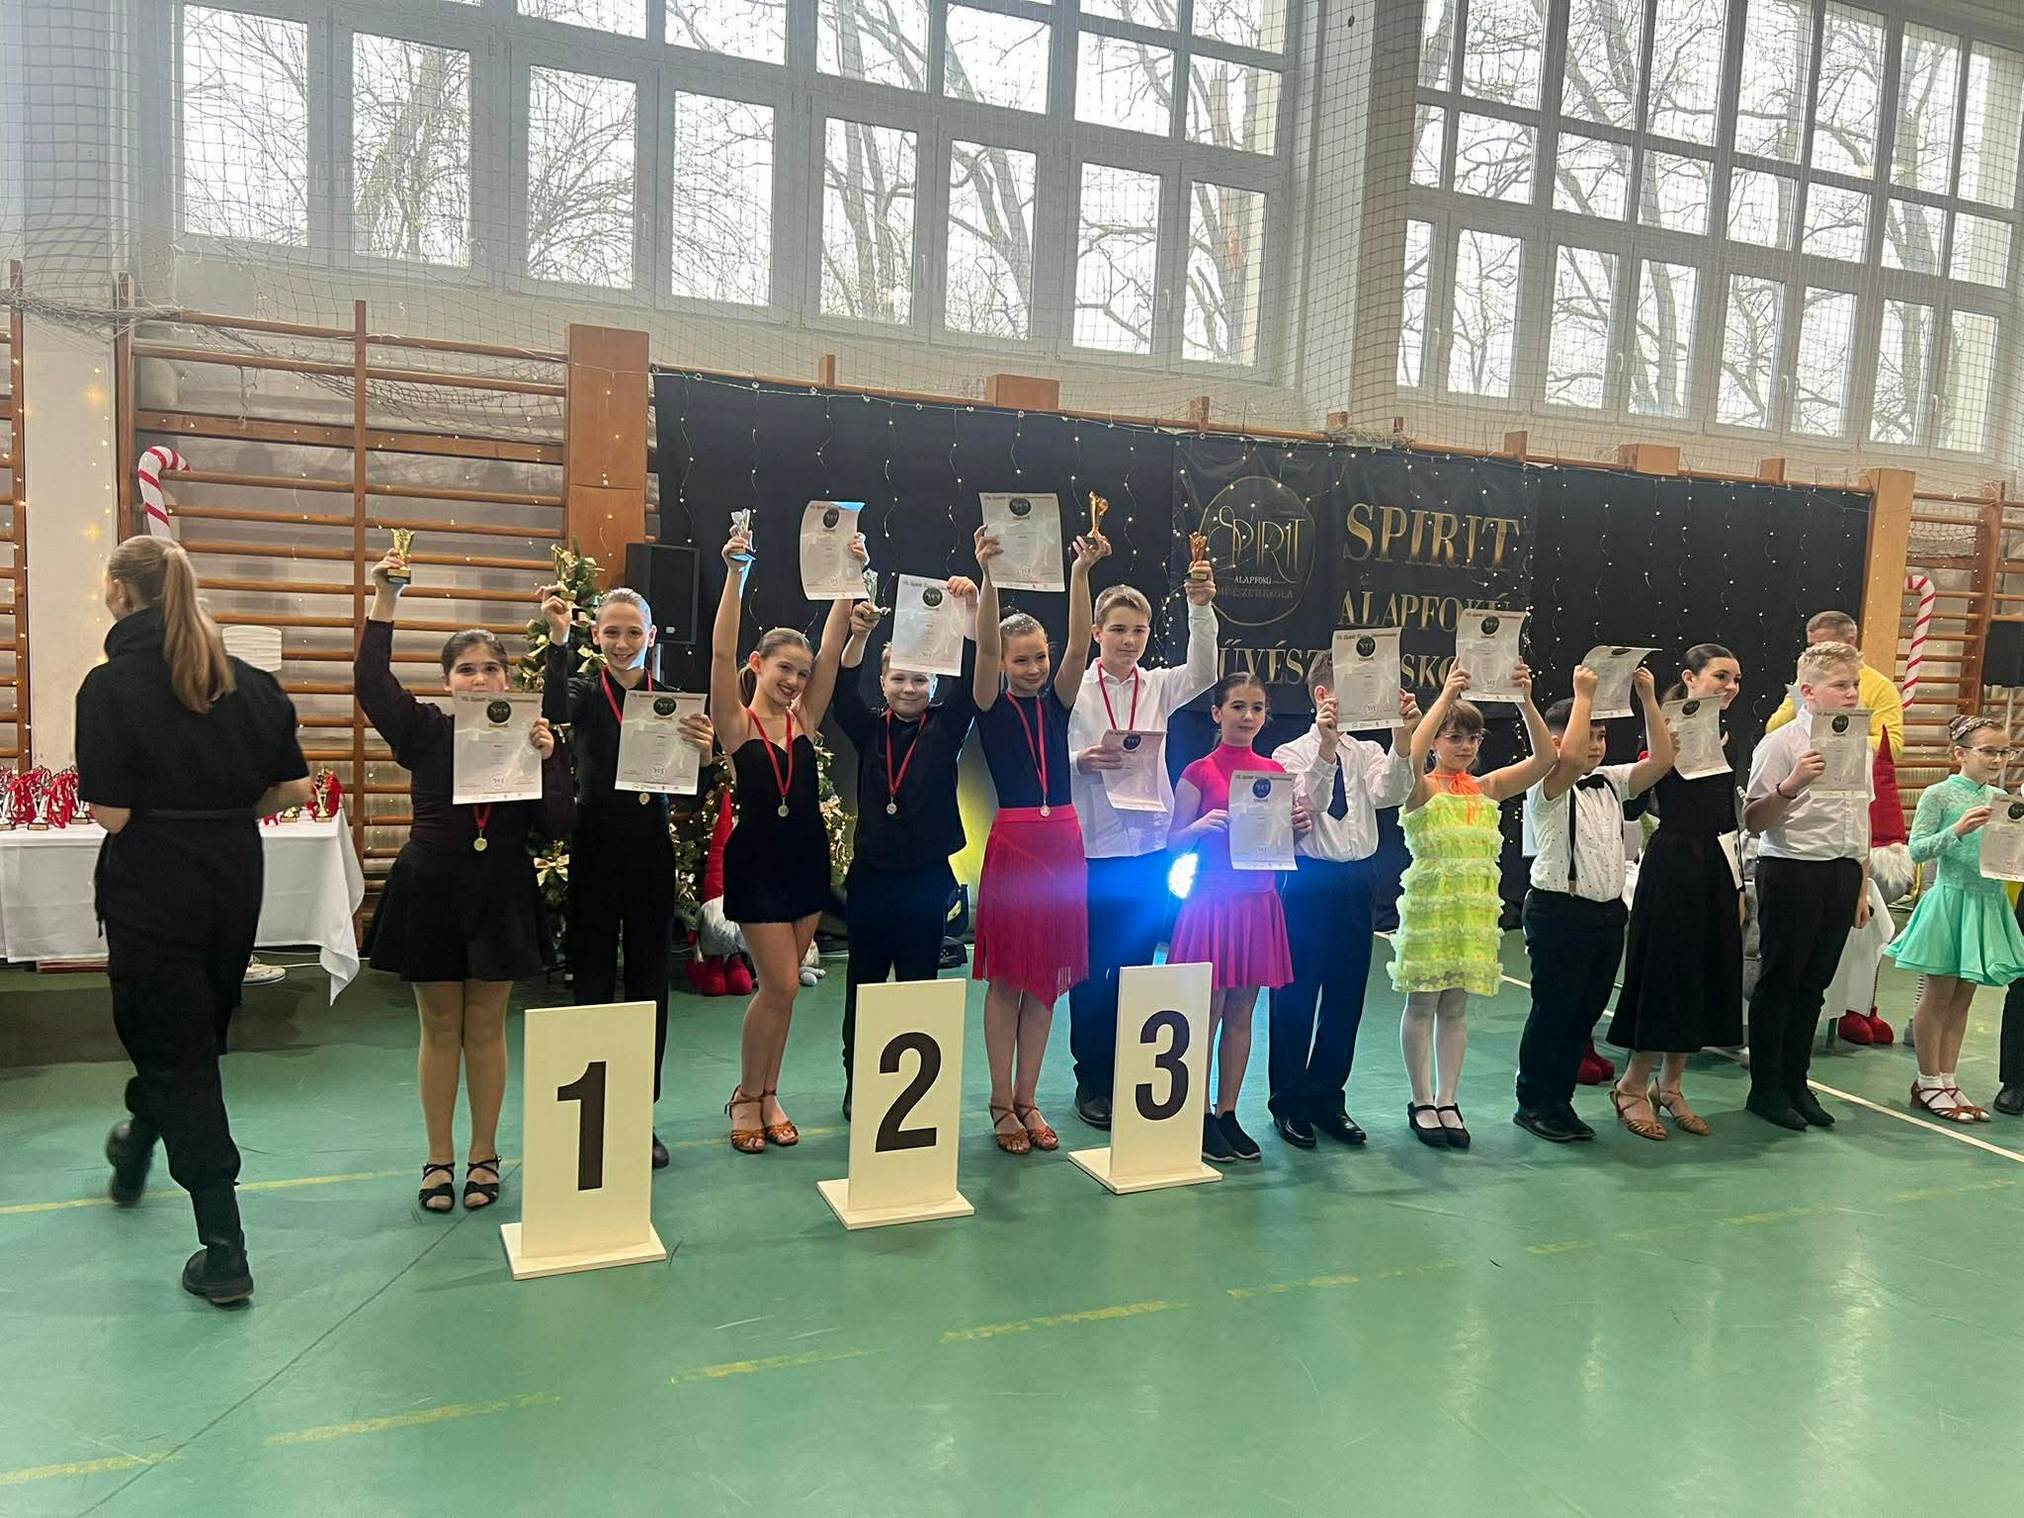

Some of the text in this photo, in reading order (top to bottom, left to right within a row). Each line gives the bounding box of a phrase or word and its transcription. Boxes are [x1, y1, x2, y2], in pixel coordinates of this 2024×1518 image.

[1208, 505, 1306, 583] SPIRIT
[1343, 502, 1521, 572] SPIRIT
[875, 1031, 942, 1153] 2
[1135, 1010, 1190, 1121] 3
[556, 1061, 607, 1192] 1
